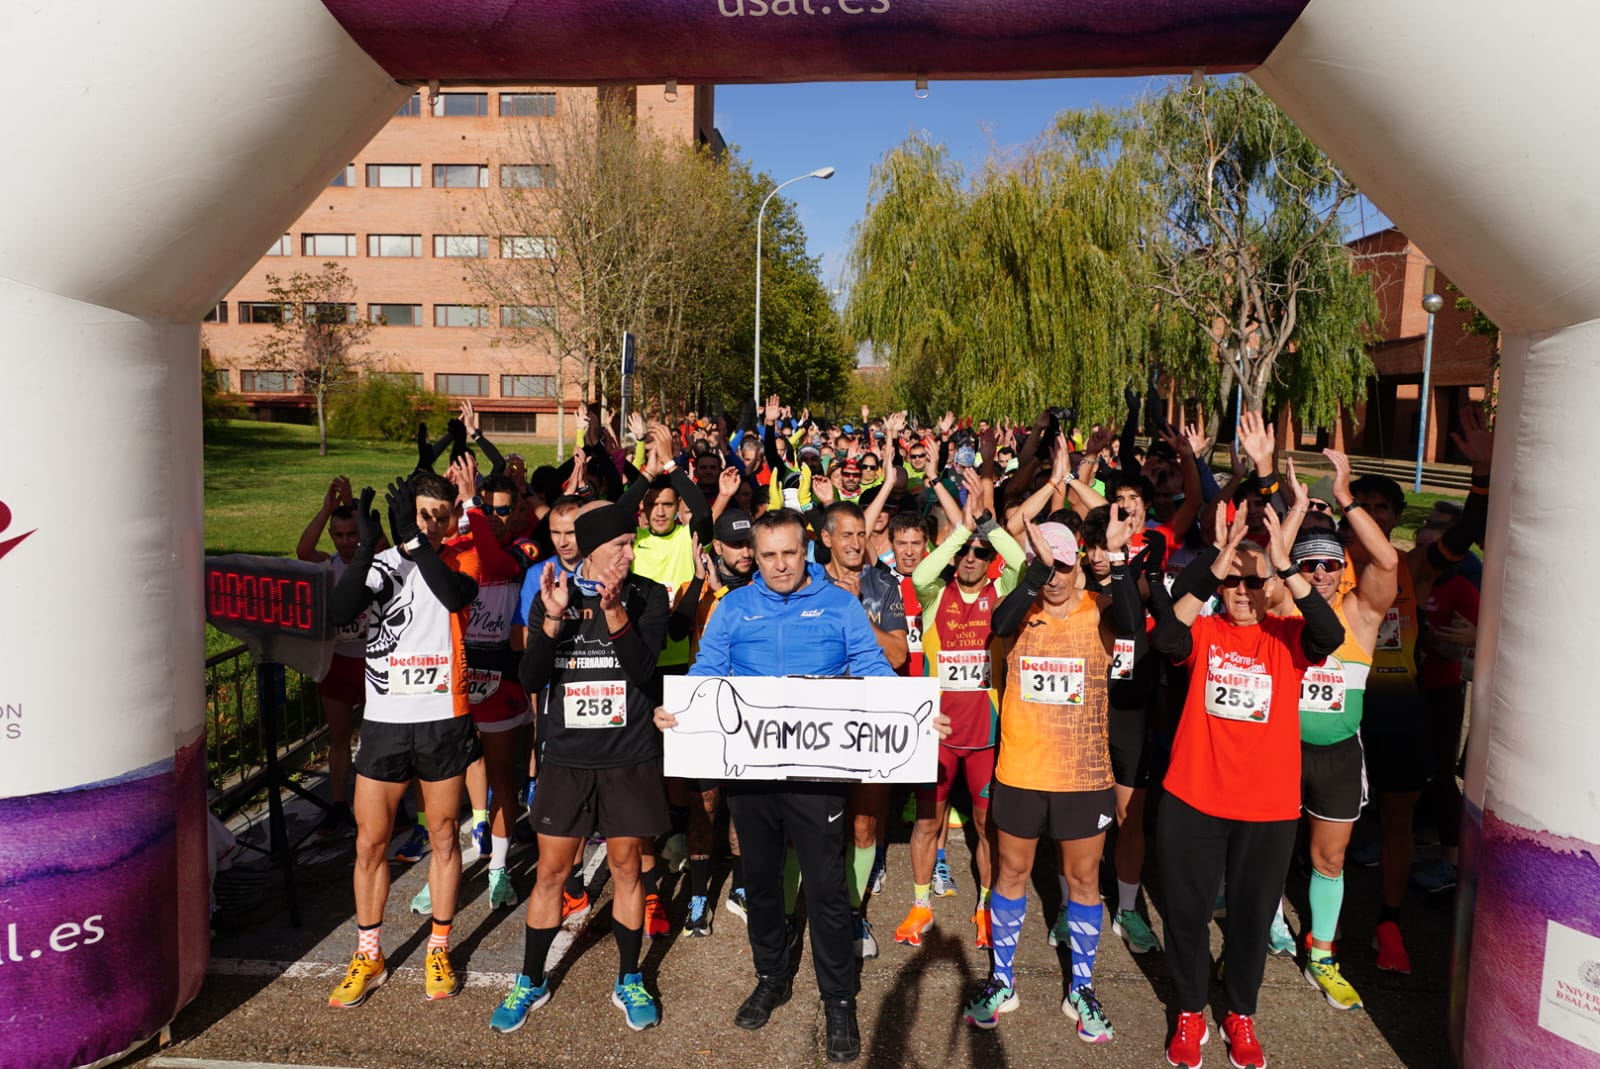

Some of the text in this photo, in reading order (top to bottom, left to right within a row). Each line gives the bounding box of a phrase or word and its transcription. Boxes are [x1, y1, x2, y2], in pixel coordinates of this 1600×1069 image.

[958, 638, 984, 647] TORO
[389, 654, 449, 667] bedunia
[576, 656, 615, 669] FERNANDO
[937, 653, 990, 664] bedunia
[1021, 660, 1083, 673] bedunia
[1112, 653, 1122, 668] 6
[401, 668, 438, 686] 127
[948, 665, 981, 681] 214
[1304, 671, 1344, 684] unia
[468, 681, 488, 696] 04
[566, 684, 625, 697] bedunia
[1033, 674, 1069, 693] 311
[1215, 686, 1256, 709] 253
[0, 703, 22, 720] N
[576, 698, 613, 717] 258
[743, 719, 909, 754] VAMOS SAMU
[0, 913, 105, 966] l.es
[1557, 979, 1600, 1005] VNIVER
[1564, 993, 1600, 1016] SALAM
